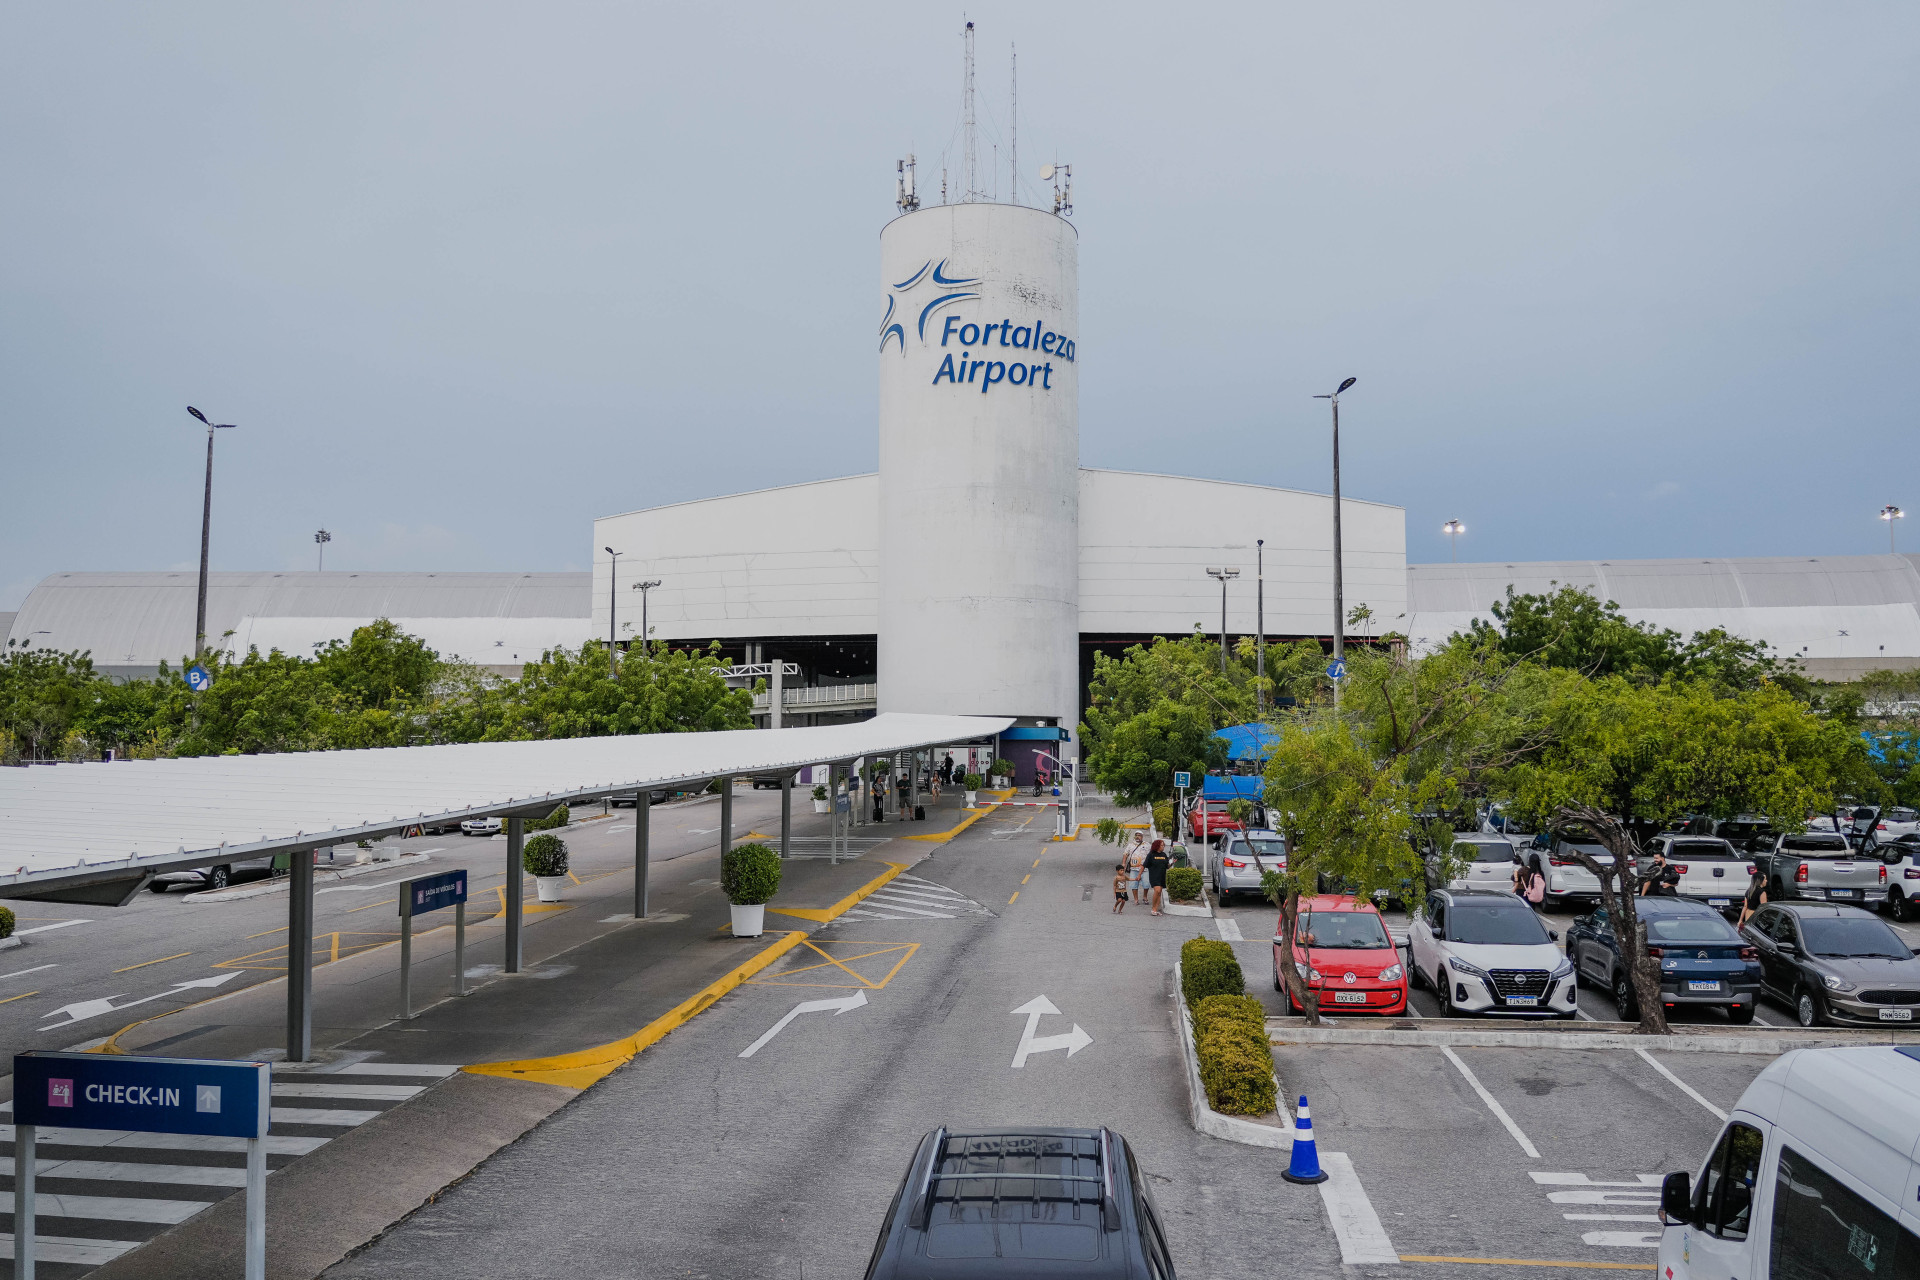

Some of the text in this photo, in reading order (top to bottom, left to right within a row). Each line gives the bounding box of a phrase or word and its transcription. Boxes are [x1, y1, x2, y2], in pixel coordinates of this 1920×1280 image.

[941, 316, 1076, 362] Fortaleza
[932, 351, 1053, 393] Airport
[190, 672, 200, 683] B
[85, 1084, 180, 1107] CHECK-IN
